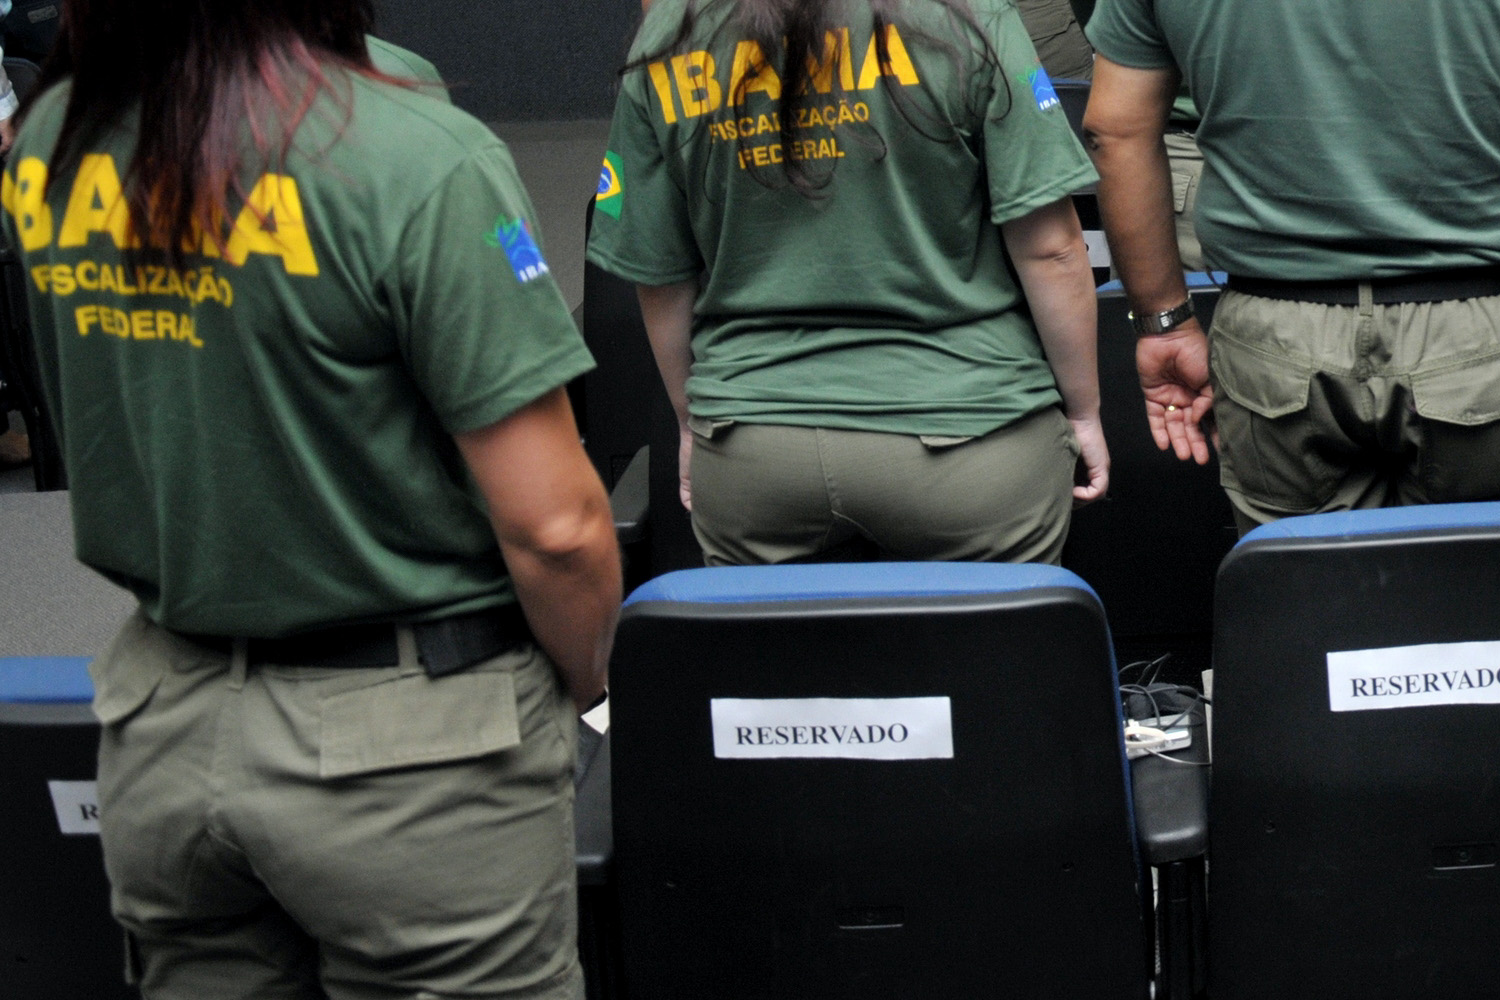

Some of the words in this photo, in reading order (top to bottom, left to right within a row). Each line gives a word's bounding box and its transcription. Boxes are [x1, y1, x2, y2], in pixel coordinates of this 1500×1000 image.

[1039, 97, 1060, 110] IBA
[708, 98, 870, 144] FISCAZAÇÃO
[31, 260, 234, 308] FSCALIZAÇÃO
[519, 260, 549, 283] IBA
[74, 304, 204, 348] FEDERAL
[735, 723, 909, 746] RESERVADO
